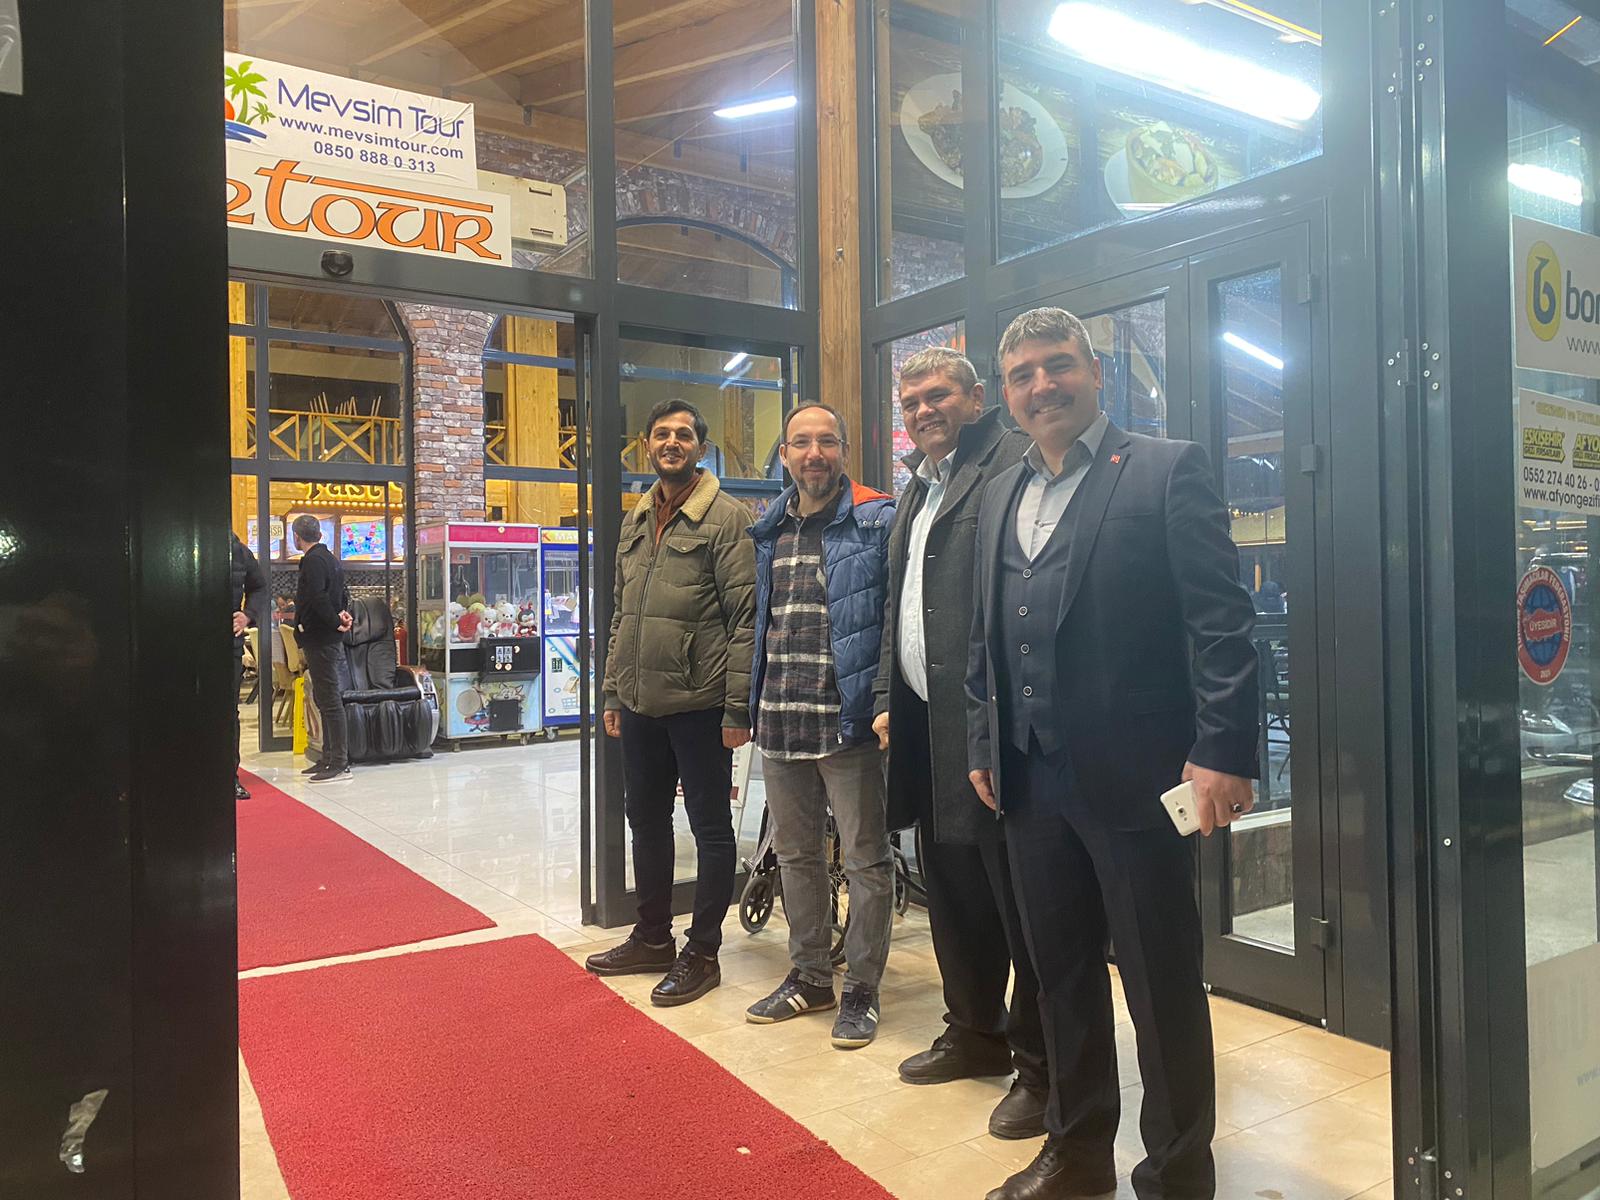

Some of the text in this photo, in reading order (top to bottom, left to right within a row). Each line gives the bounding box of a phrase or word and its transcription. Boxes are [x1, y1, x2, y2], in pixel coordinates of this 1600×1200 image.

[278, 78, 464, 139] Mevsim Tour
[279, 116, 463, 159] www.mevsimtour.com
[314, 141, 436, 174] 0850 888 0 313
[1576, 434, 1600, 454] AFYO
[1523, 466, 1545, 484] 0552
[1547, 470, 1562, 486] 274
[1564, 473, 1575, 488] 40
[1577, 475, 1588, 490] 26
